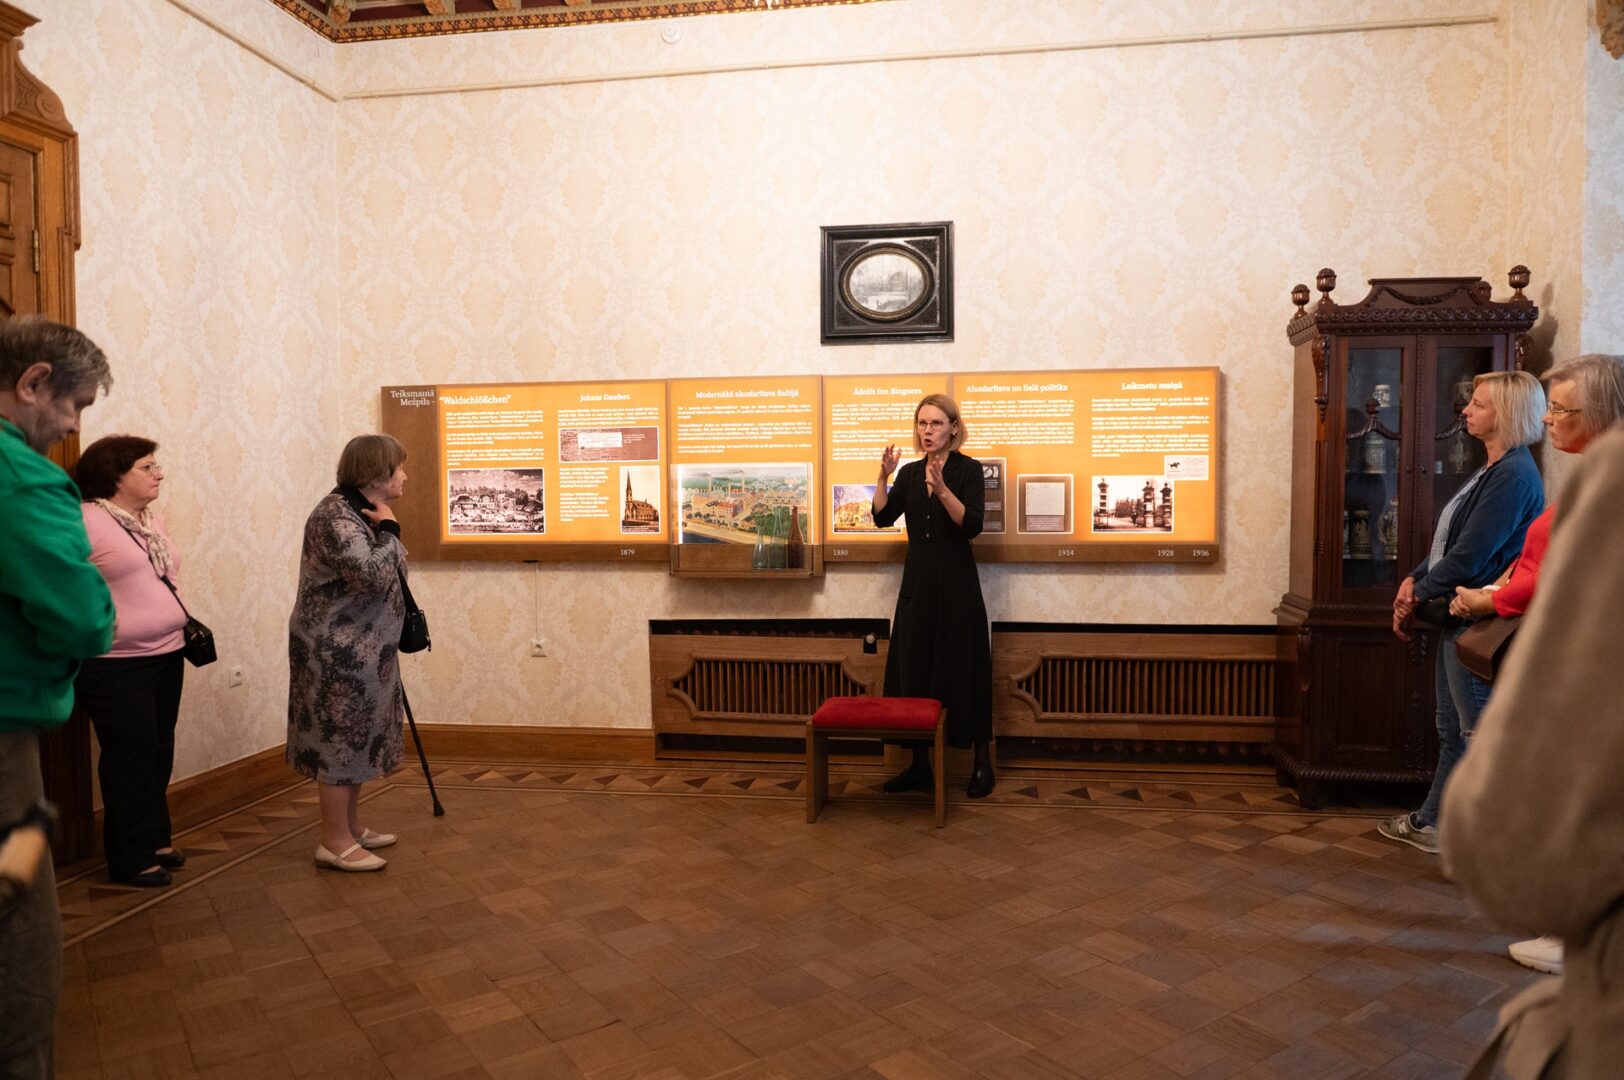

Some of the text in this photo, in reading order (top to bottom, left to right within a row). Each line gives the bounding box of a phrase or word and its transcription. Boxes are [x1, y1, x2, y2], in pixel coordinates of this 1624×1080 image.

[1040, 384, 1068, 393] politika
[400, 397, 430, 408] Mežpils
[1157, 549, 1174, 557] 1928
[1192, 549, 1210, 557] 1936
